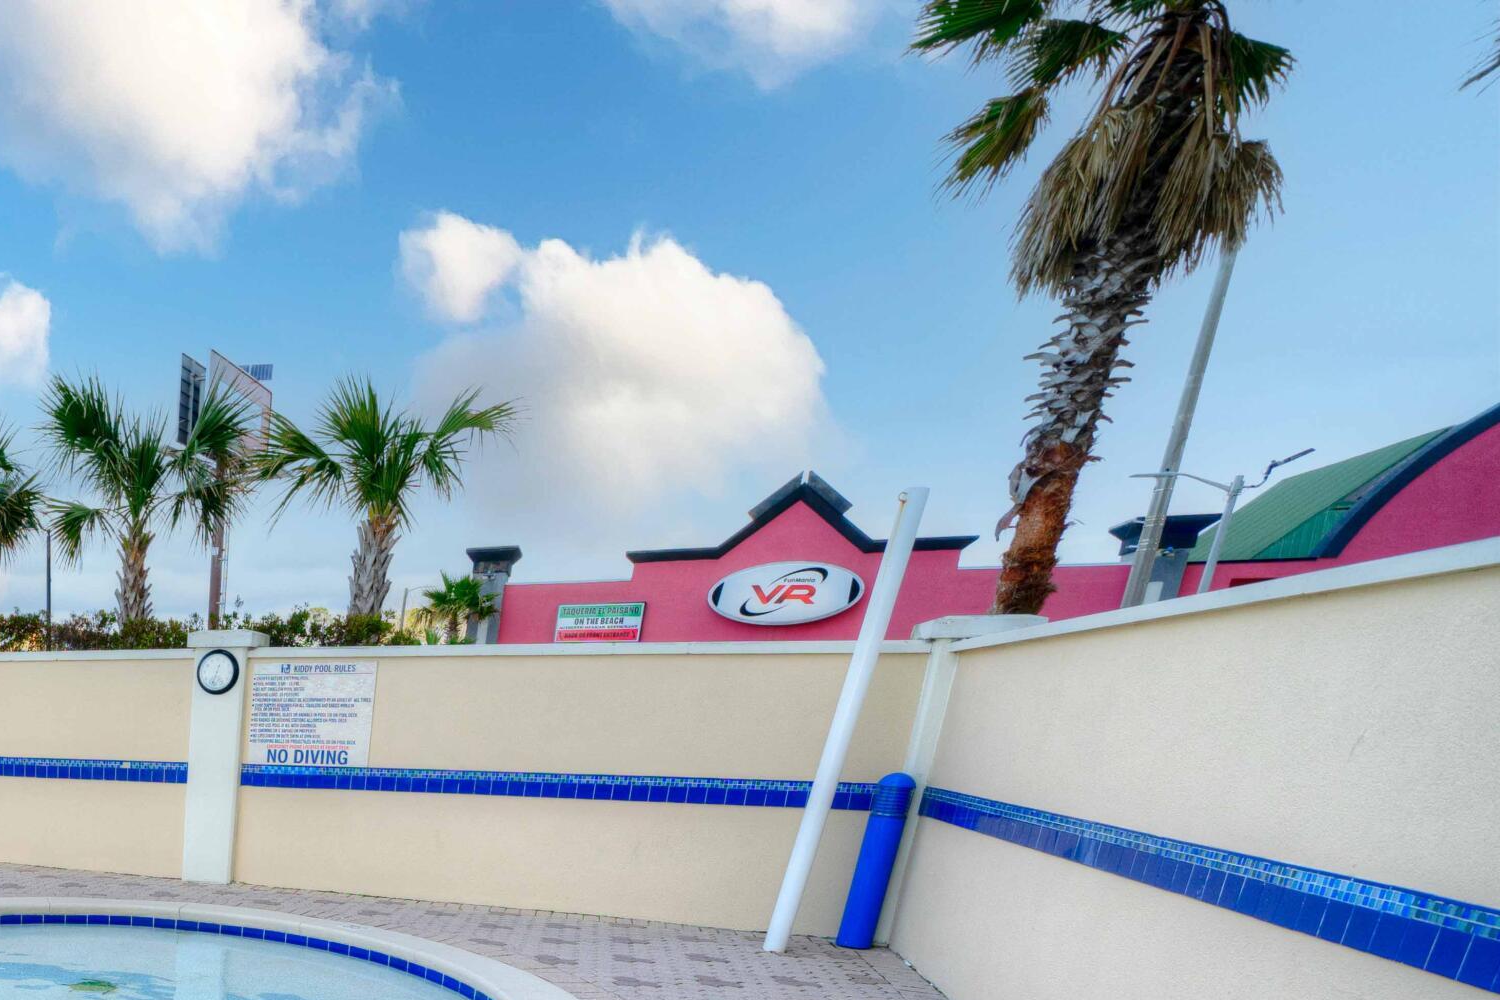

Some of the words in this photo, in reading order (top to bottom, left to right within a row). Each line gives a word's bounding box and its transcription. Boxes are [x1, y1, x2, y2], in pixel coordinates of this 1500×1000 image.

[752, 585, 816, 604] VR
[563, 607, 596, 615] TAQUERIA
[607, 606, 640, 614] PAISANO
[600, 617, 624, 625] BEACH
[267, 749, 288, 763] NO
[293, 749, 348, 765] DIVING
